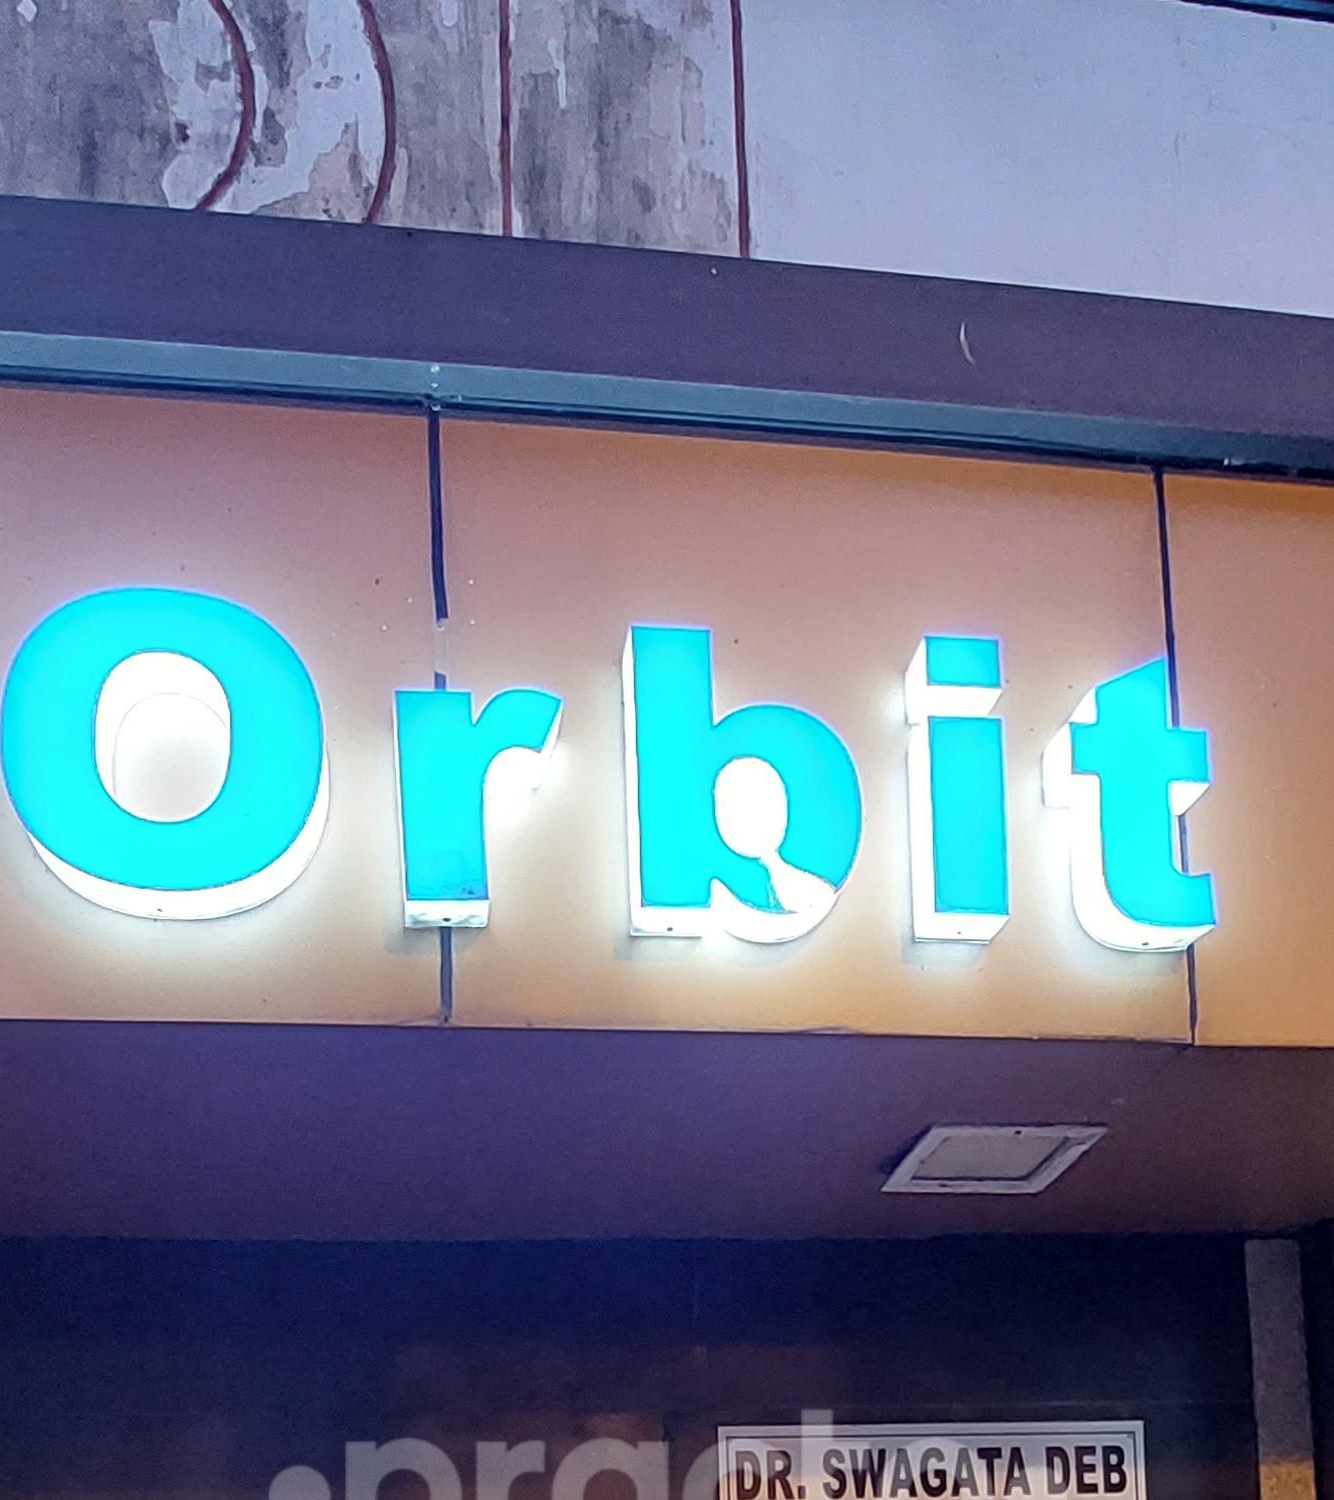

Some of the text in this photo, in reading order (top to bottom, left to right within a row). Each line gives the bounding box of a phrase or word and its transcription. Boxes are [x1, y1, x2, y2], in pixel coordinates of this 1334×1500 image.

[0, 587, 1216, 930] Orbit
[734, 1444, 1128, 1500] DR. SWAGATA DEB
